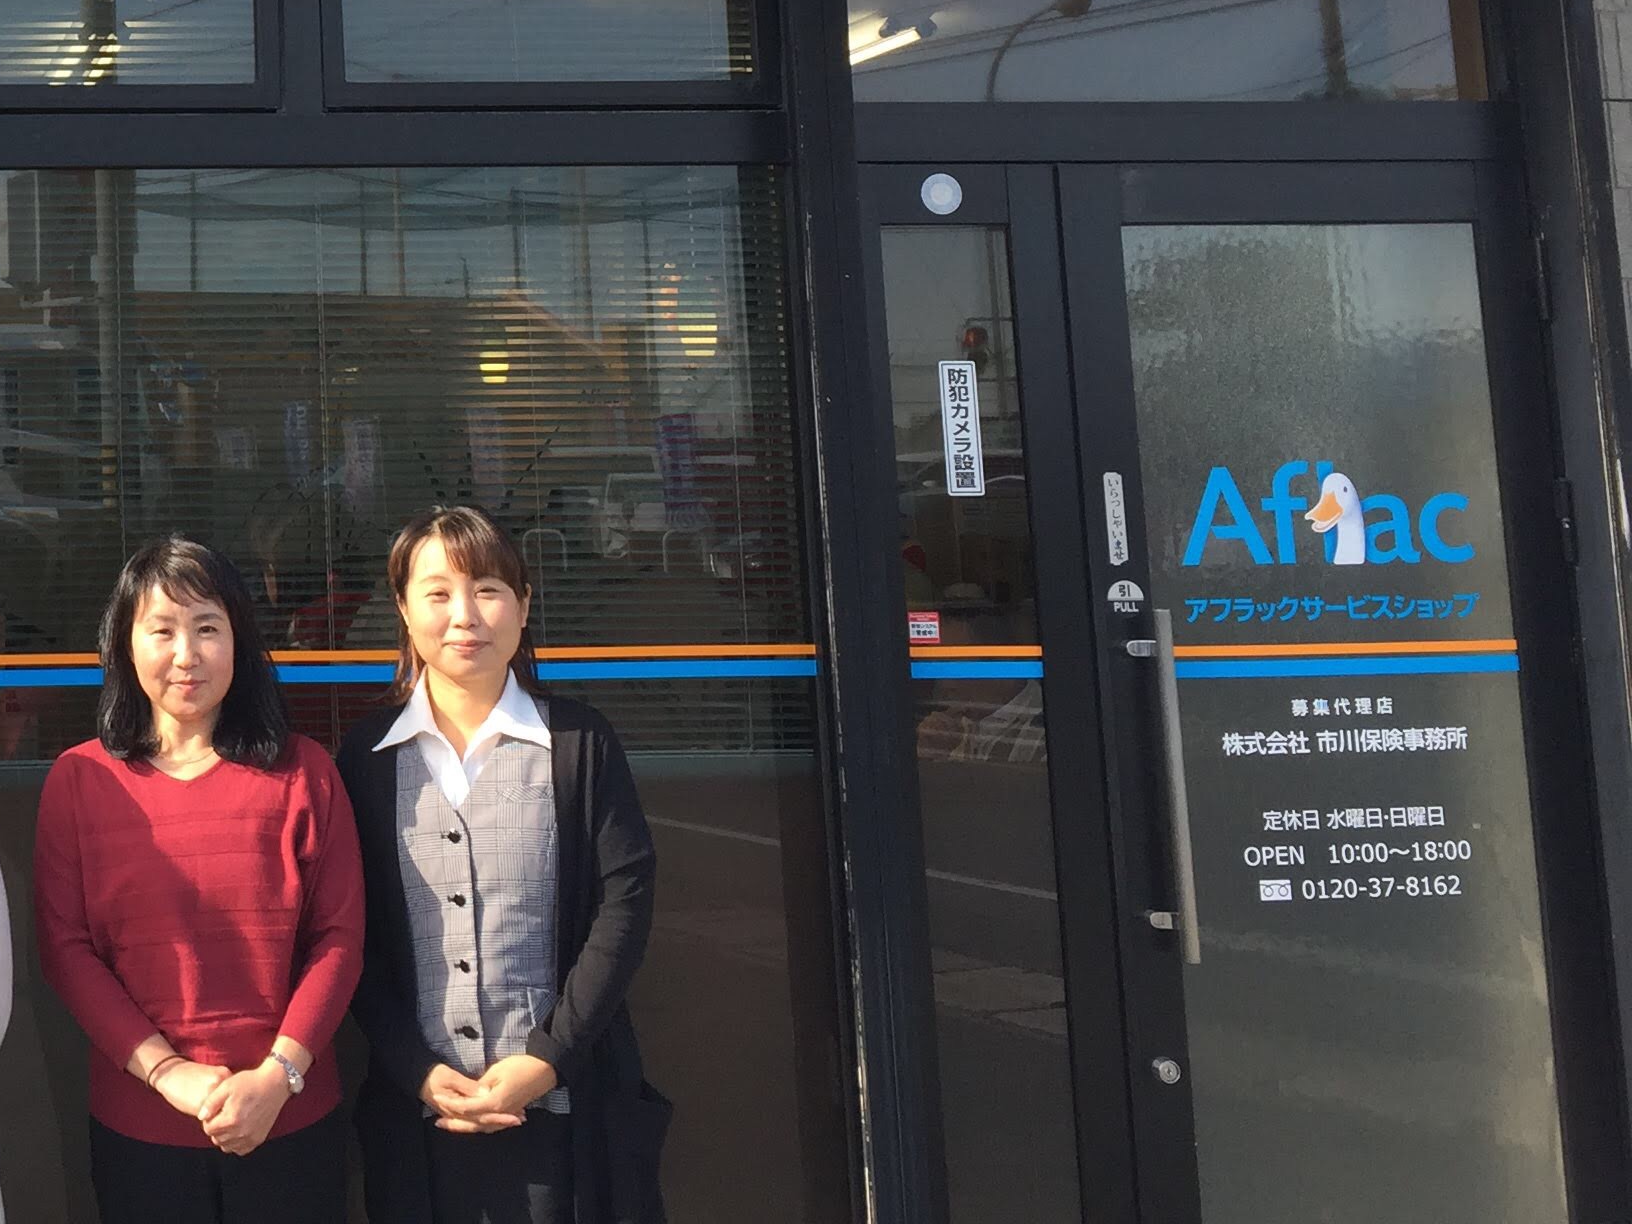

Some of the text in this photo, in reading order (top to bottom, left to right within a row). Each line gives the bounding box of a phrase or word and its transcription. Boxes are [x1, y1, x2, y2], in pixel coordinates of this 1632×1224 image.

[947, 368, 977, 489] 防犯カメラ設置
[1181, 459, 1476, 566] Aflac
[1118, 584, 1131, 597] 引
[1113, 601, 1139, 613] PULL
[1184, 592, 1479, 624] アフラックサービスショップ
[1291, 696, 1394, 718] 募集代理店
[1222, 726, 1468, 757] 株式会社 市川保険事務所
[1262, 810, 1320, 831] 定休日
[1244, 845, 1306, 866] OPEN
[1301, 876, 1462, 901] 0120-37-8162
